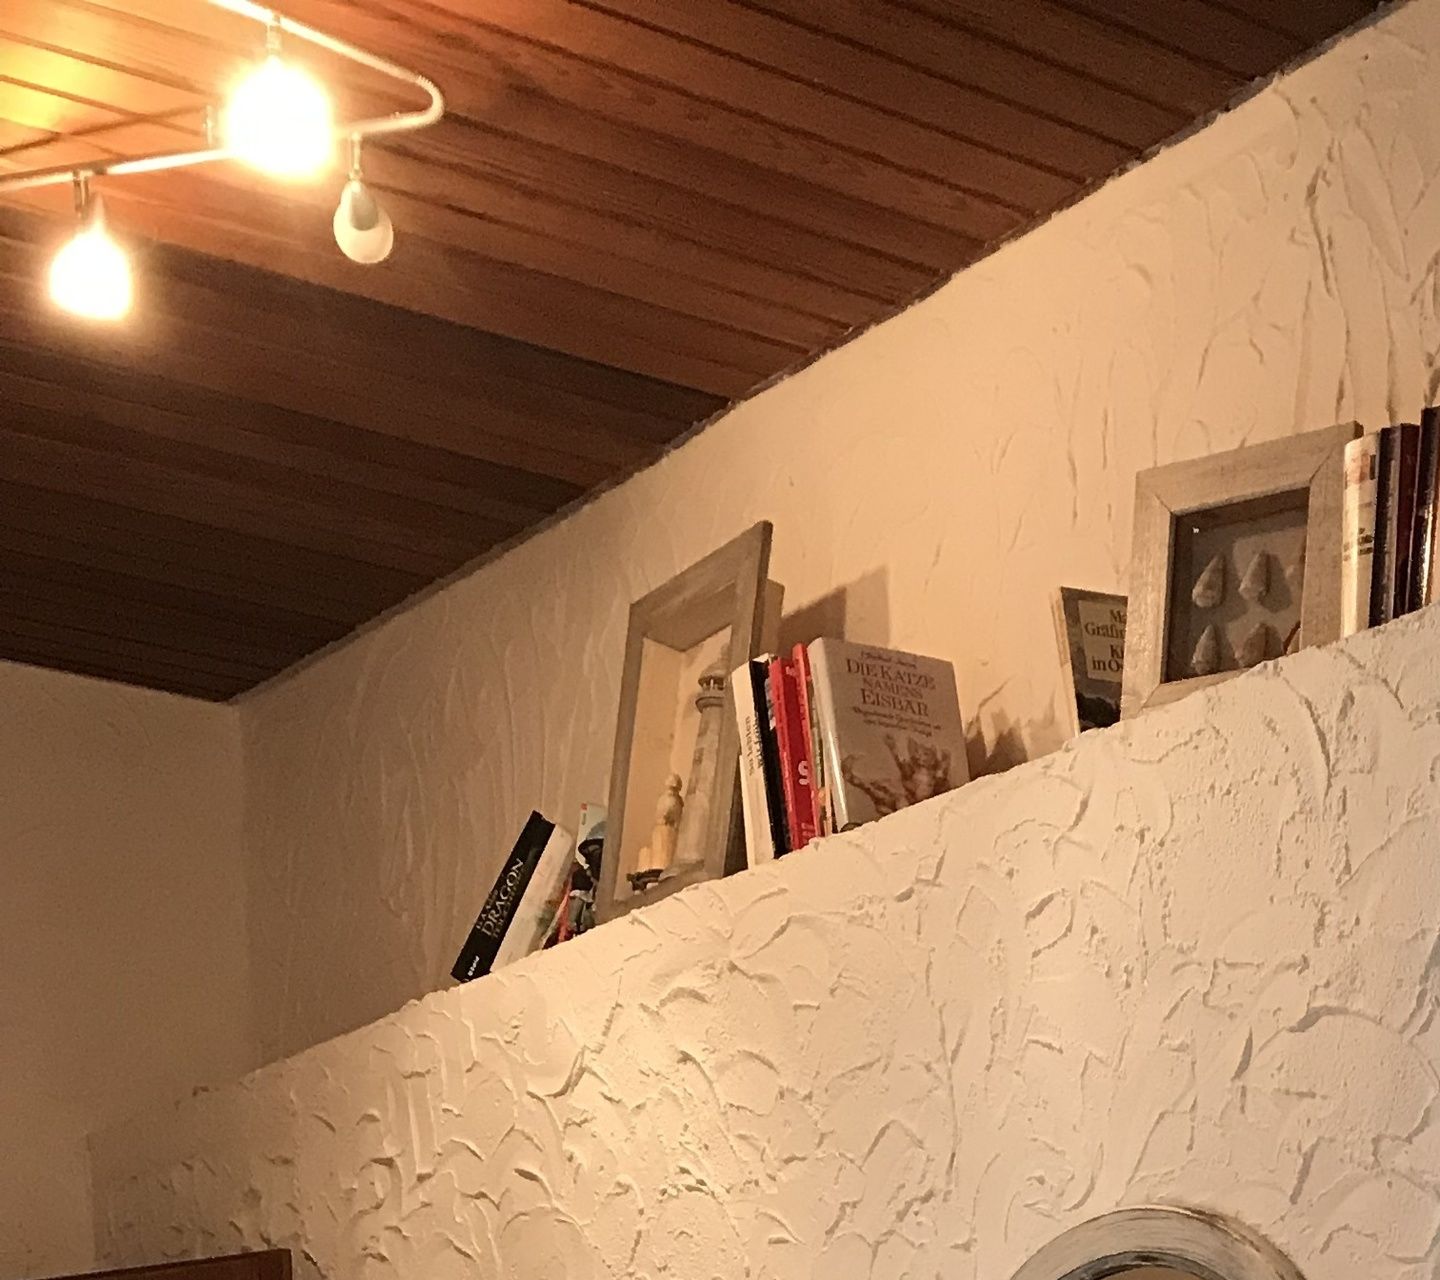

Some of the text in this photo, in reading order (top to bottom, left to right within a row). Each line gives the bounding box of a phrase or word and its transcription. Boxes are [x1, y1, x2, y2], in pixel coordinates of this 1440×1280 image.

[847, 658, 878, 678] DIE
[881, 664, 936, 690] KATZE
[481, 858, 524, 937] DRAGON
